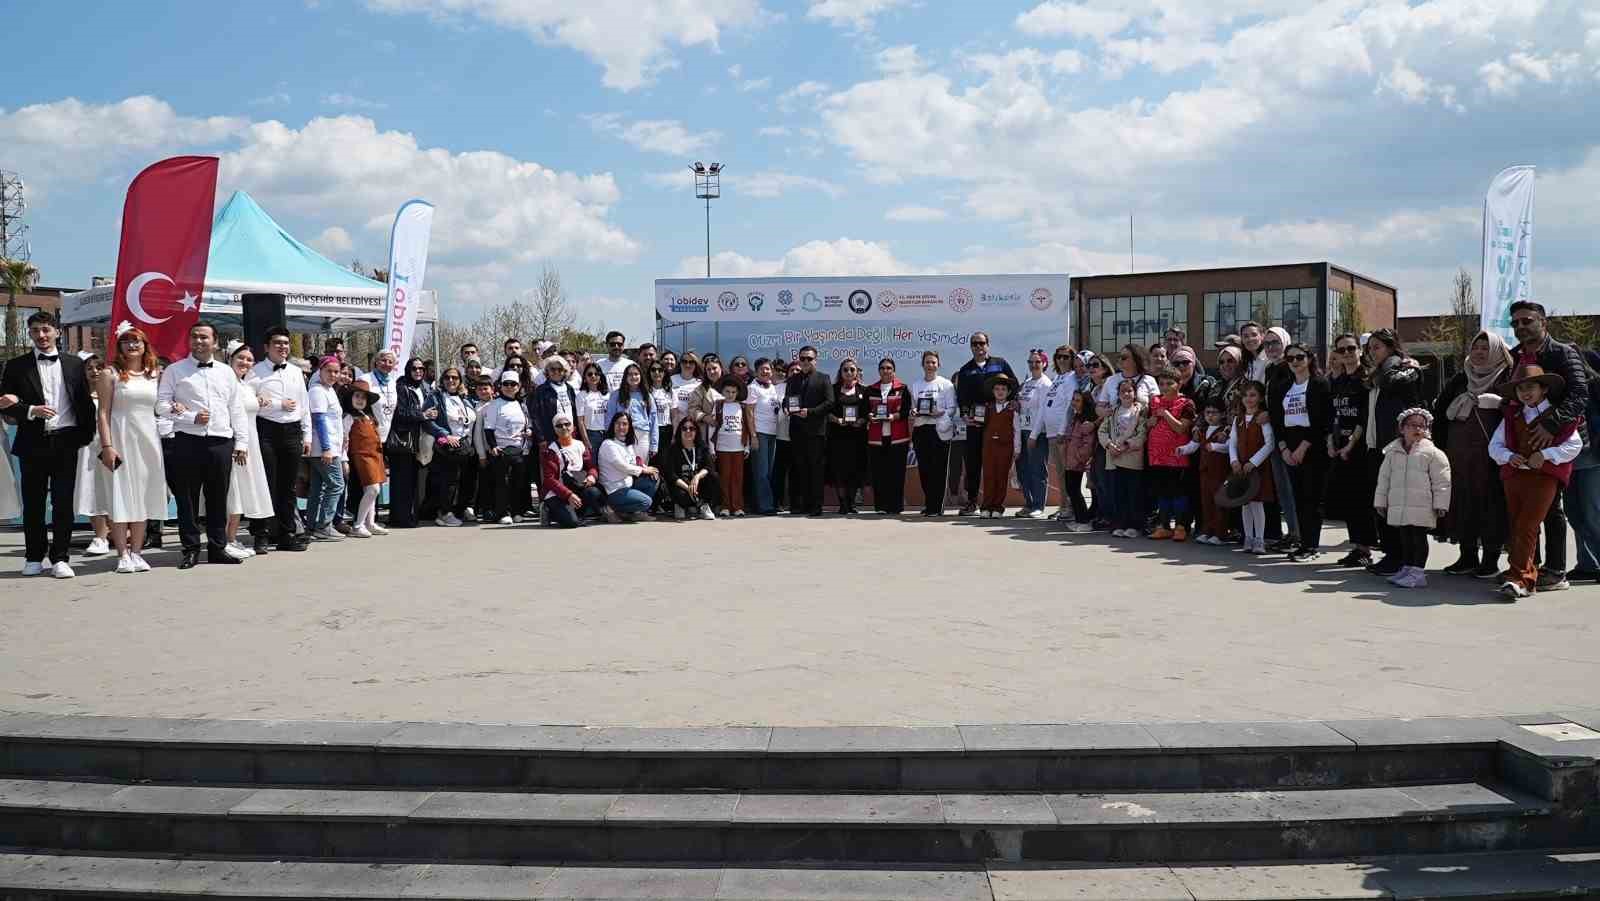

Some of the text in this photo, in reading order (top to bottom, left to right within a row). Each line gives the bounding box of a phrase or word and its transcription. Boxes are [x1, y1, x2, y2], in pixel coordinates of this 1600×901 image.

[286, 294, 334, 305] ÜYÜKŞEHİR
[1113, 314, 1168, 336] mavi
[894, 328, 912, 342] Her
